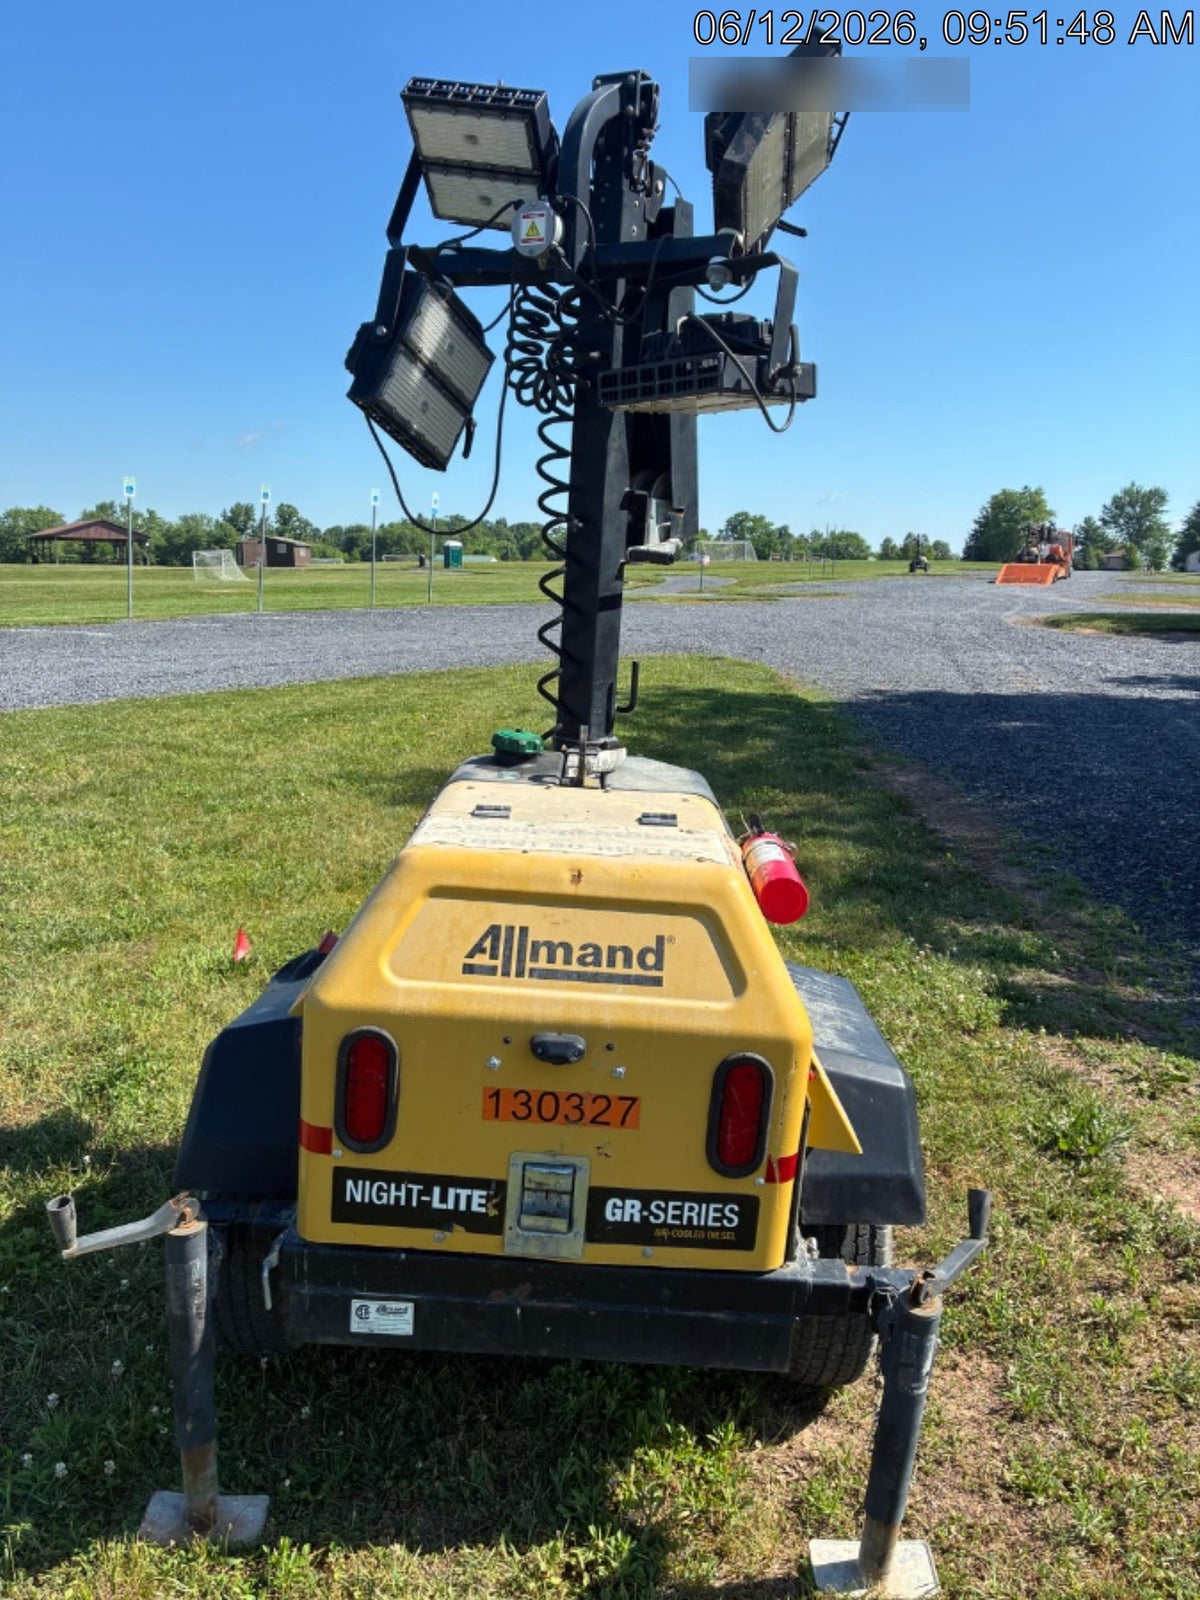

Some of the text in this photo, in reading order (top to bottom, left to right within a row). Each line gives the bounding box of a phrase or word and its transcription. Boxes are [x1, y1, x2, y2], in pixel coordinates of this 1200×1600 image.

[487, 1087, 639, 1127] 130327
[345, 1178, 488, 1213] NIGHT-LITE
[605, 1197, 739, 1228] GR-SERIES
